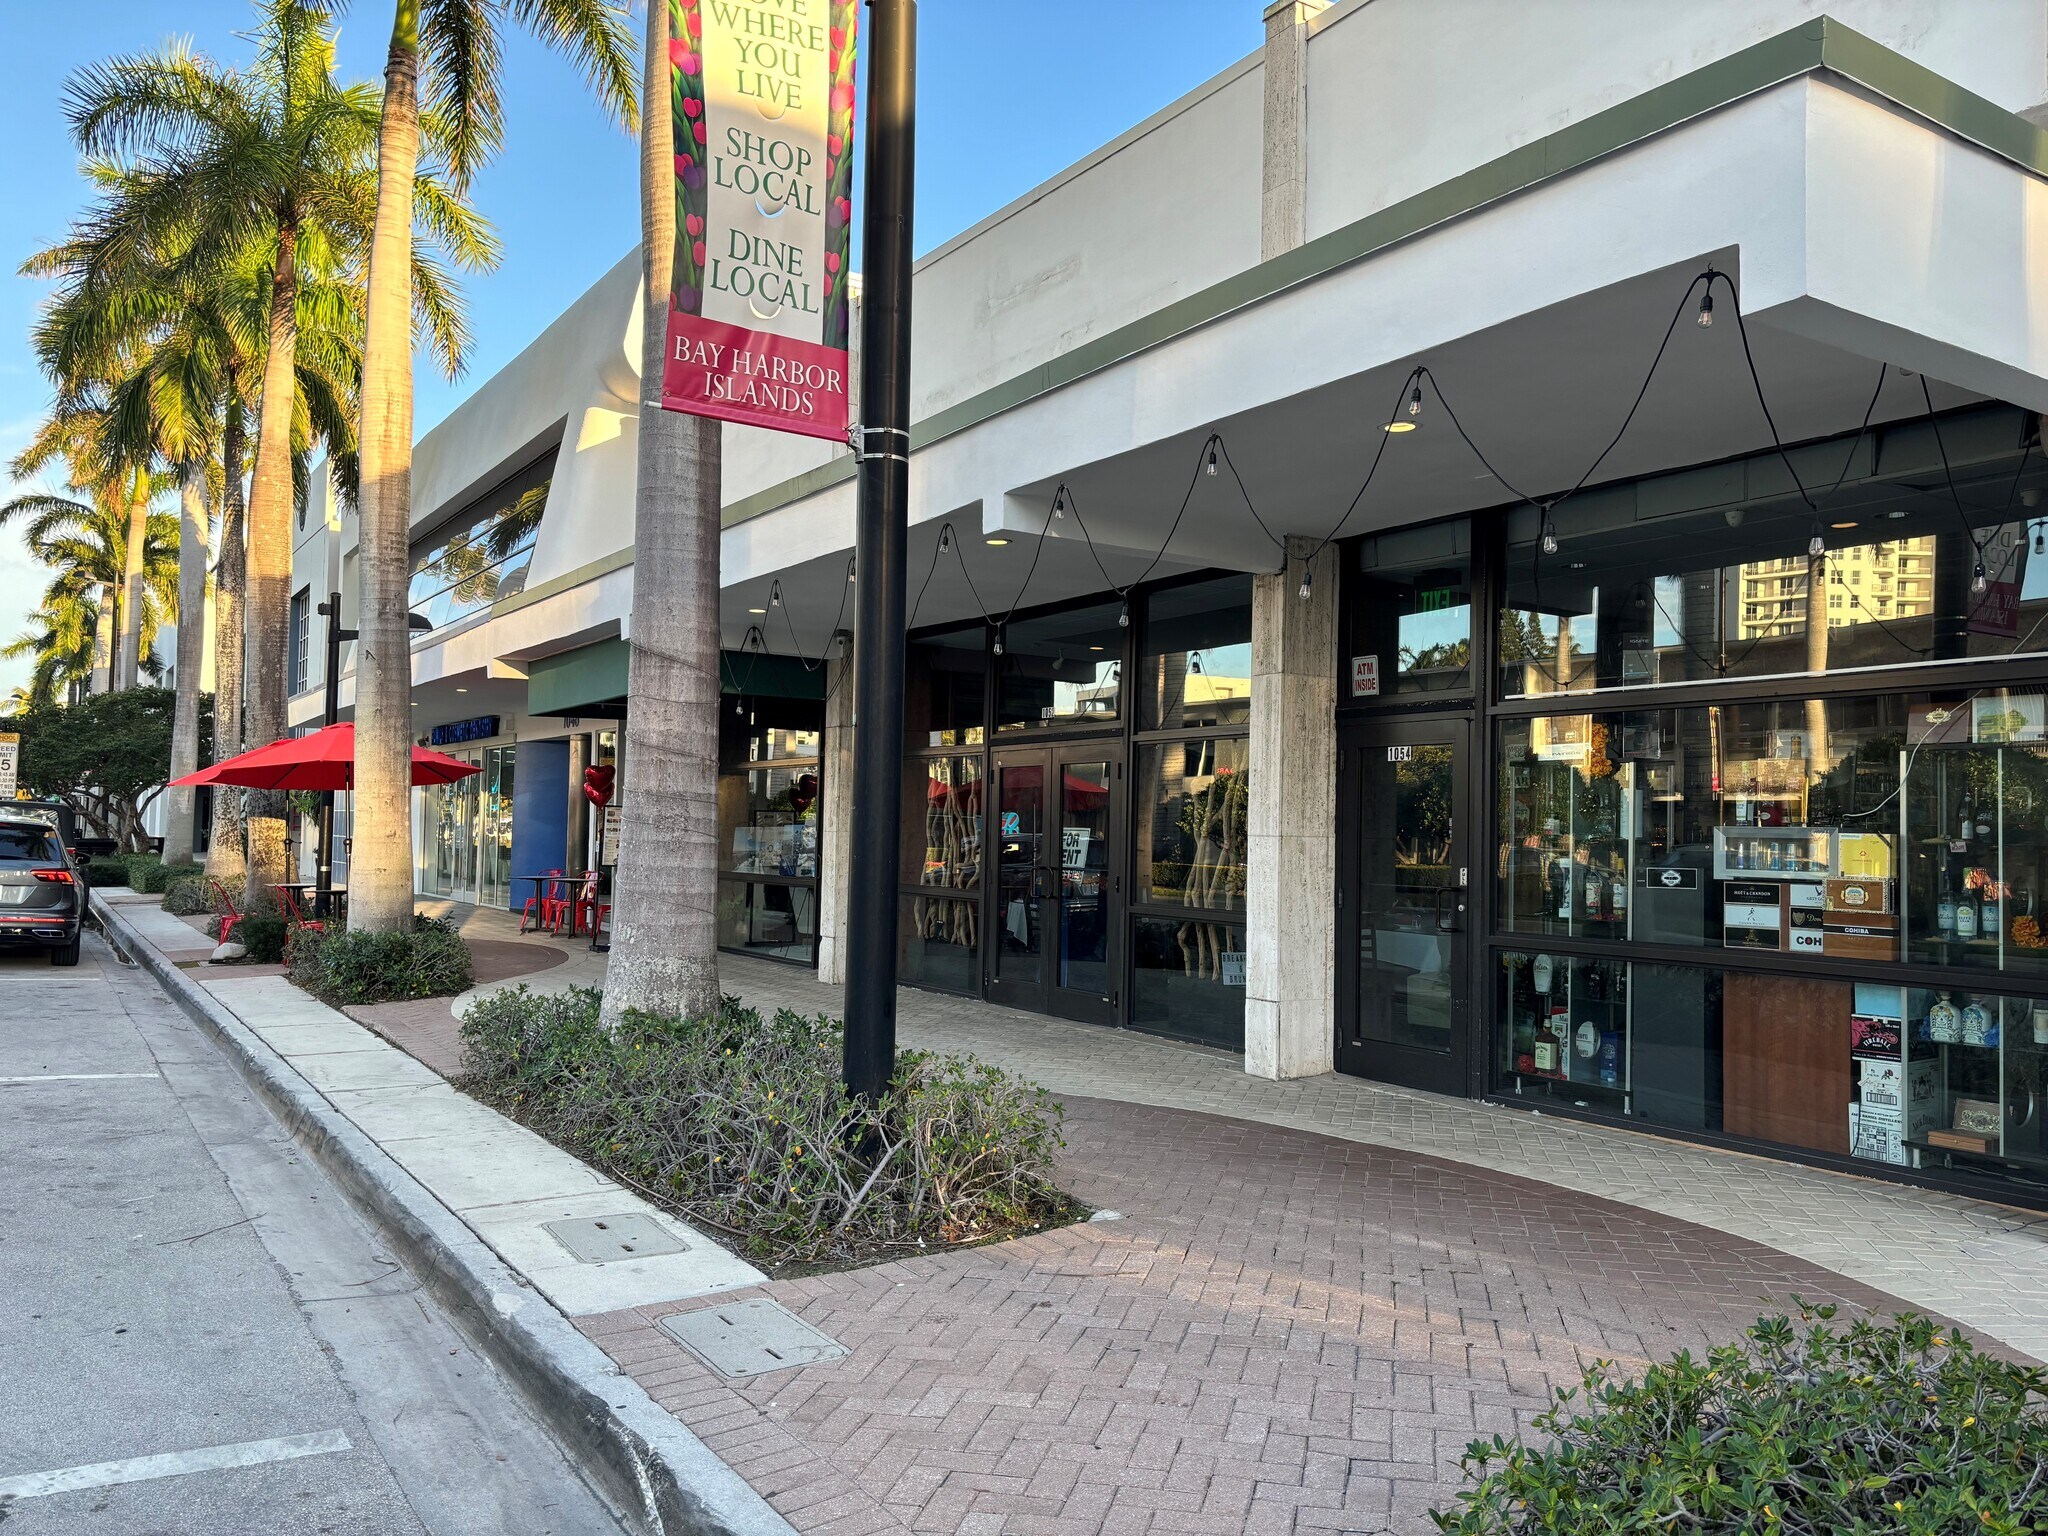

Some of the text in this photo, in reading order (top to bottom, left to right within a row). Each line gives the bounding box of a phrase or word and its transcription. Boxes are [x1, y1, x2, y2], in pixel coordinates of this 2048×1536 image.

[710, 0, 825, 52] WHERE
[733, 37, 802, 79] YOU
[736, 68, 802, 110] LIVE
[726, 126, 812, 177] SHOP
[714, 156, 821, 216] LOCAL
[727, 227, 803, 277] DINE
[710, 258, 819, 314] LOCAL
[673, 335, 843, 394] BAY HARBOR
[703, 371, 814, 416] ISLANDS
[1355, 677, 1376, 692] INSIDE
[1357, 662, 1374, 676] ATM
[1389, 747, 1411, 761] 1054
[1796, 936, 1822, 947] COH
[1844, 926, 1869, 935] COHIBA
